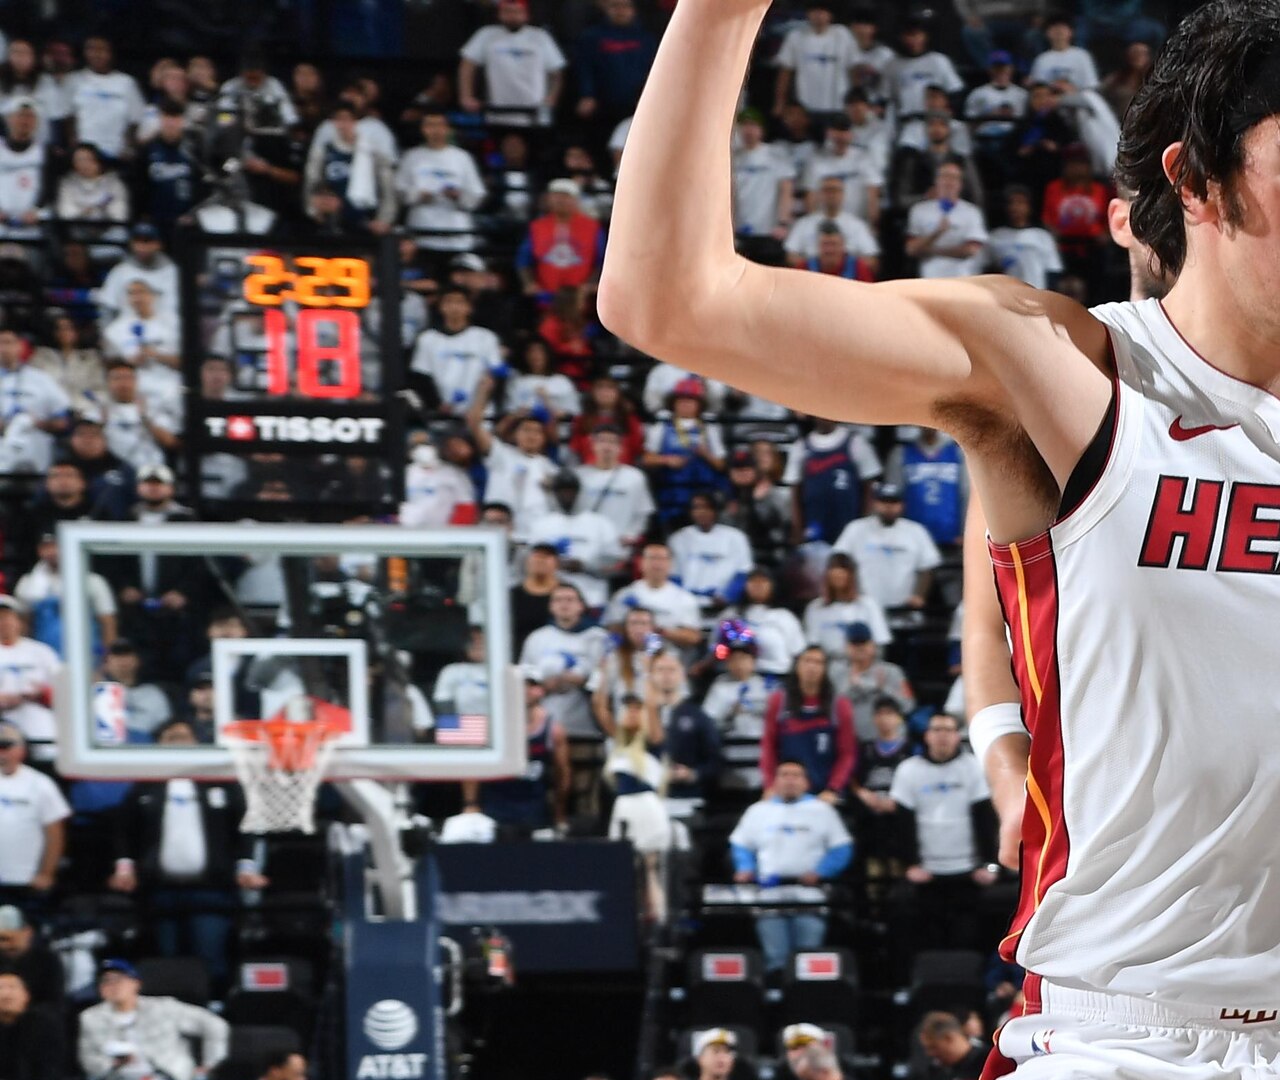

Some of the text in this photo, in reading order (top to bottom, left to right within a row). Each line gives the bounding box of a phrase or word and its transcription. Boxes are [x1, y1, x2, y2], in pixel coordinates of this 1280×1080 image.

[243, 255, 371, 307] 2:29
[264, 308, 362, 398] 18
[254, 416, 384, 442] TISSOT
[357, 1054, 426, 1080] AT&T
